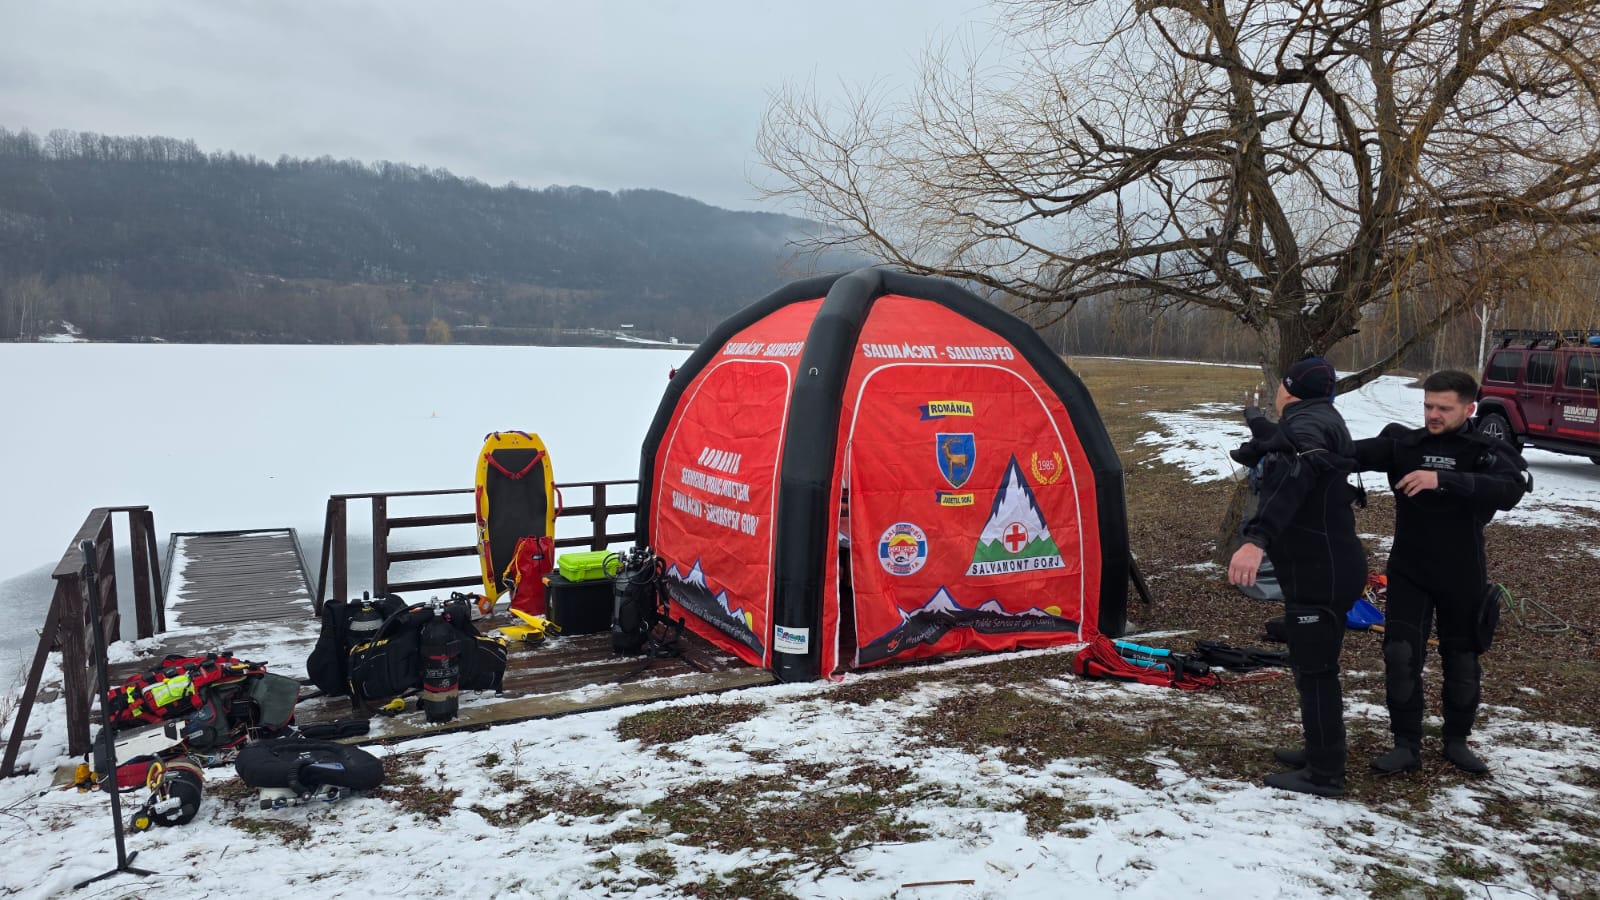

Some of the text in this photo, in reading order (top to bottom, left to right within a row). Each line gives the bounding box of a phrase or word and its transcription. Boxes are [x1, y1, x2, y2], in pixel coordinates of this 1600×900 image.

[862, 342, 938, 359] SALVAMONT
[946, 346, 1014, 361] SALVASPEO
[930, 402, 972, 414] ROMÂNIA
[1038, 460, 1055, 471] 1985
[972, 556, 1060, 575] SALVAMONT GORJ
